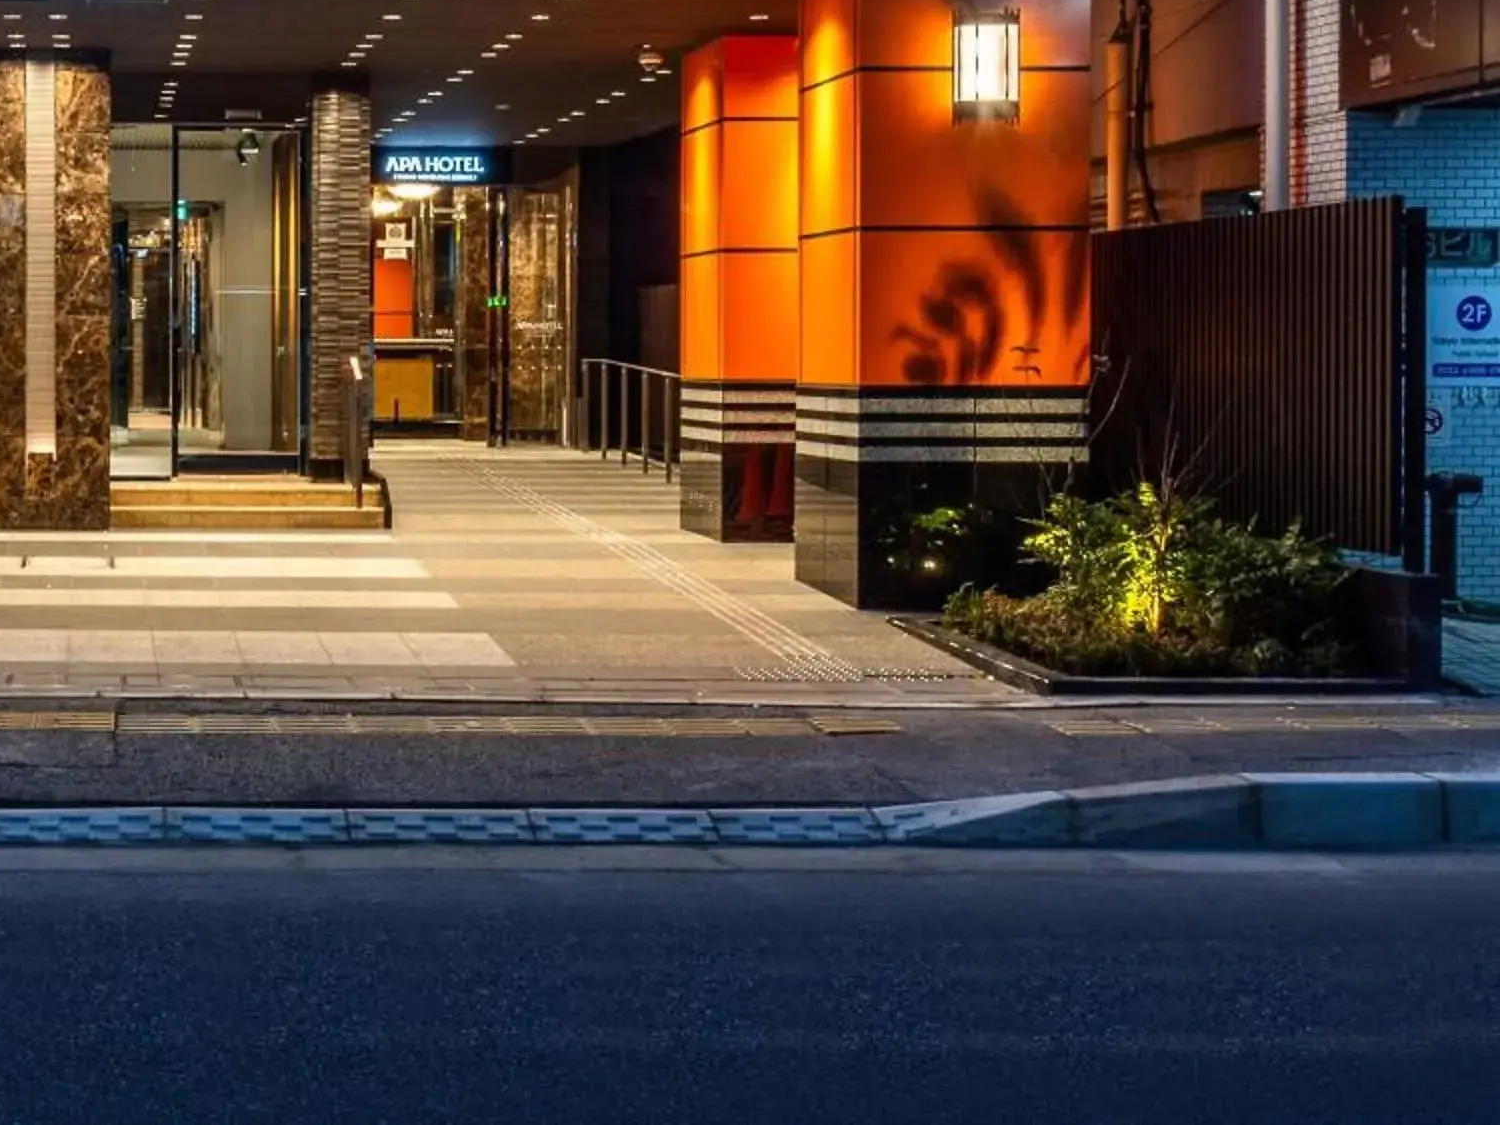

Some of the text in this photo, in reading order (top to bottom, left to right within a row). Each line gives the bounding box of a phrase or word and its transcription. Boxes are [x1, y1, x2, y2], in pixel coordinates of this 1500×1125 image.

[385, 156, 484, 173] APA HOTEL
[1462, 303, 1487, 323] 2F
